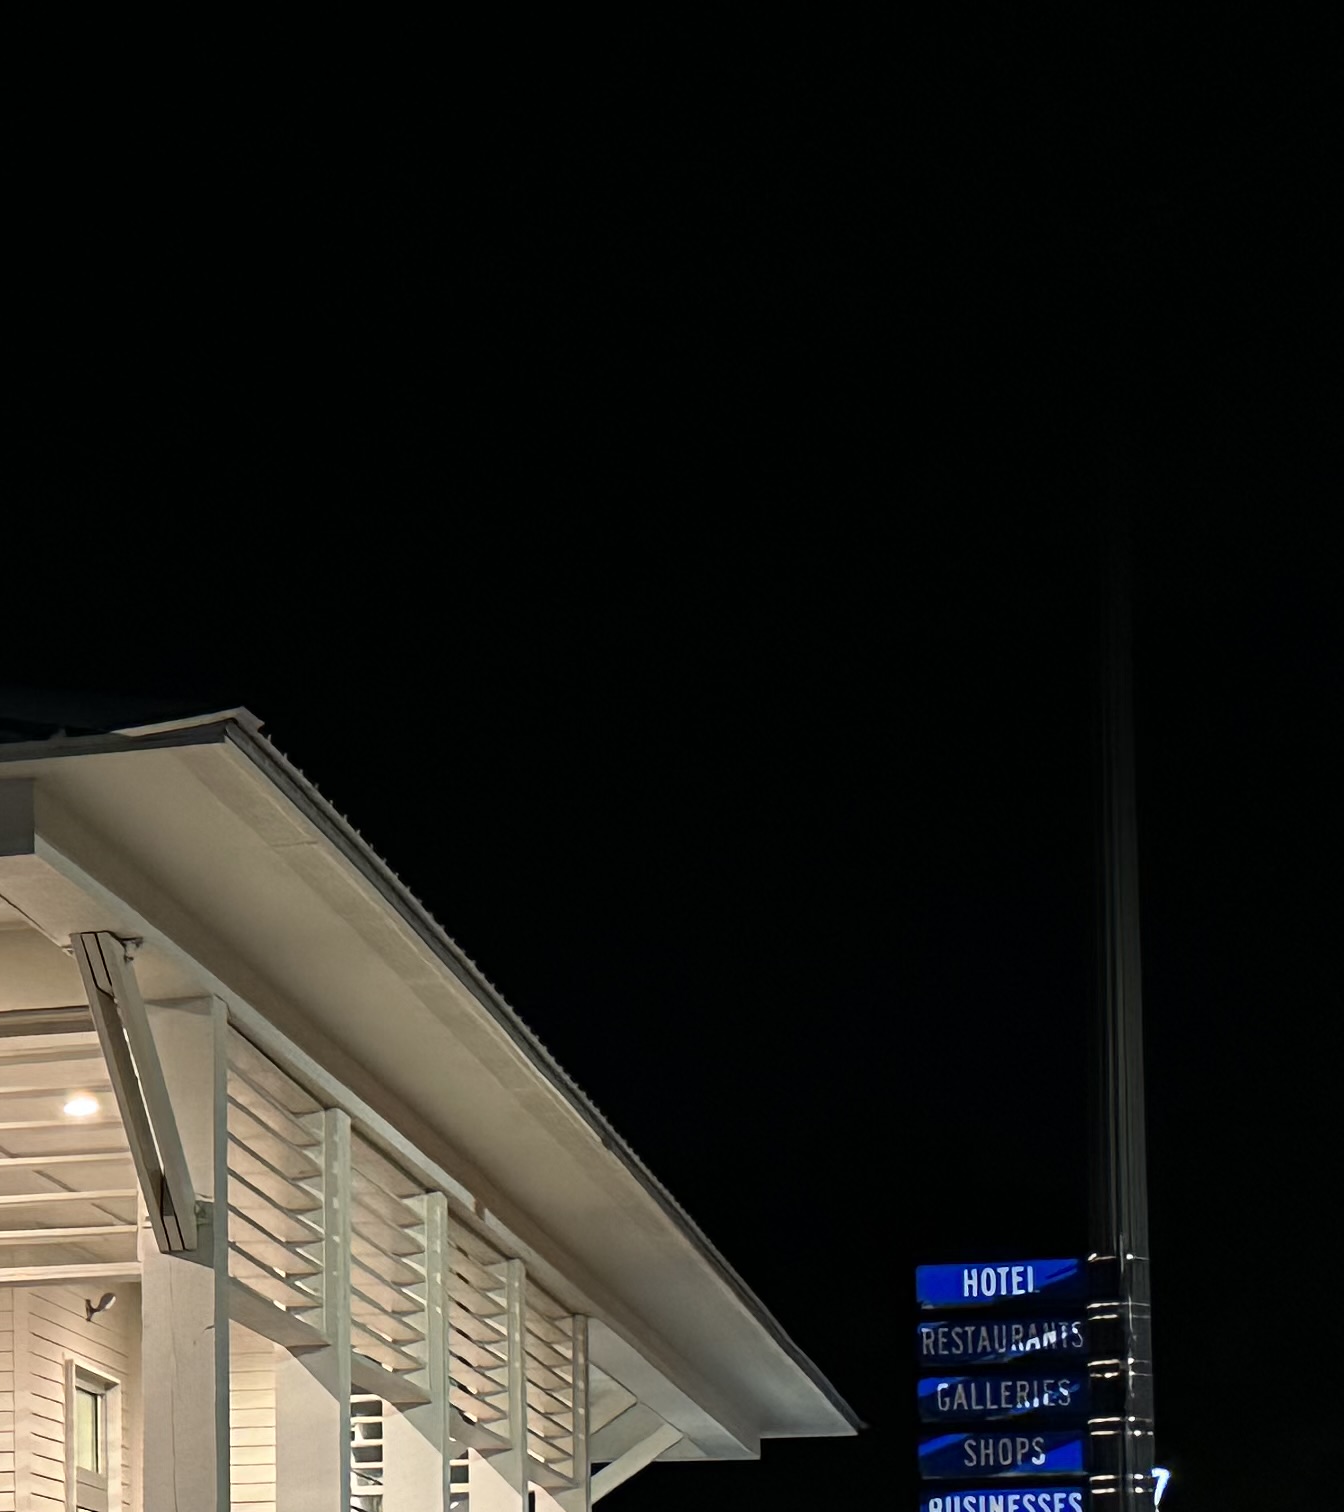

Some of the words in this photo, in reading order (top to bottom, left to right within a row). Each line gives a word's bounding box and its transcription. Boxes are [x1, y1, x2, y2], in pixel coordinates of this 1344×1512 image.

[963, 1266, 1040, 1297] HOTEL
[921, 1321, 1084, 1354] RESTAURANTS
[937, 1379, 1072, 1411] GALLERIES
[963, 1437, 1046, 1466] SHOPS
